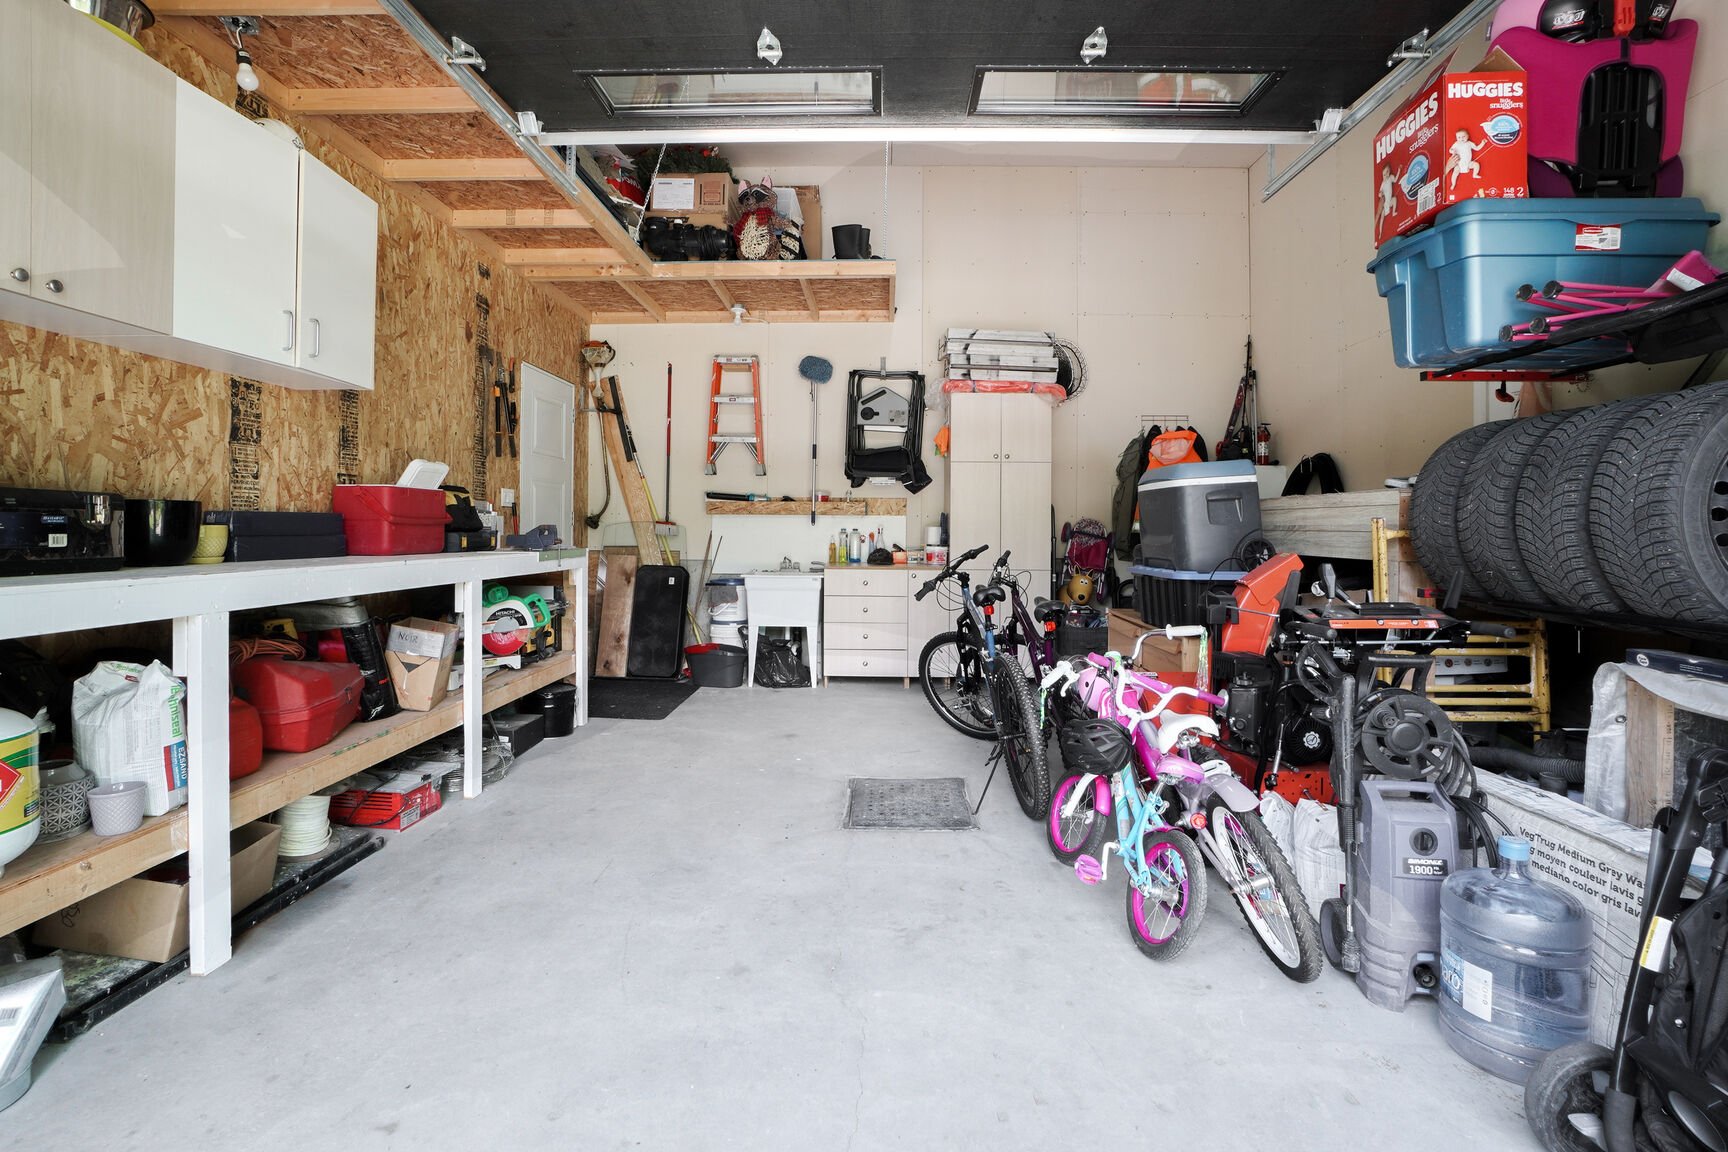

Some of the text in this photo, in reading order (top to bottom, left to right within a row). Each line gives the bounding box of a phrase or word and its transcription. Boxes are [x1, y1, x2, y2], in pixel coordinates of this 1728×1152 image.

[1447, 82, 1524, 98] HUGGIES
[1376, 92, 1438, 164] HUGGIES
[1516, 186, 1524, 197] 2
[1409, 865, 1433, 875] 1900
[1519, 826, 1645, 889] VegTrug Medium Grey Wa
[1537, 849, 1567, 869] moyen
[1568, 863, 1608, 887] couleur
[1609, 880, 1635, 900] lavis
[1531, 859, 1571, 884] mediano
[1572, 880, 1600, 897] color
[1601, 894, 1622, 912] gris
[1624, 903, 1641, 918] lav
